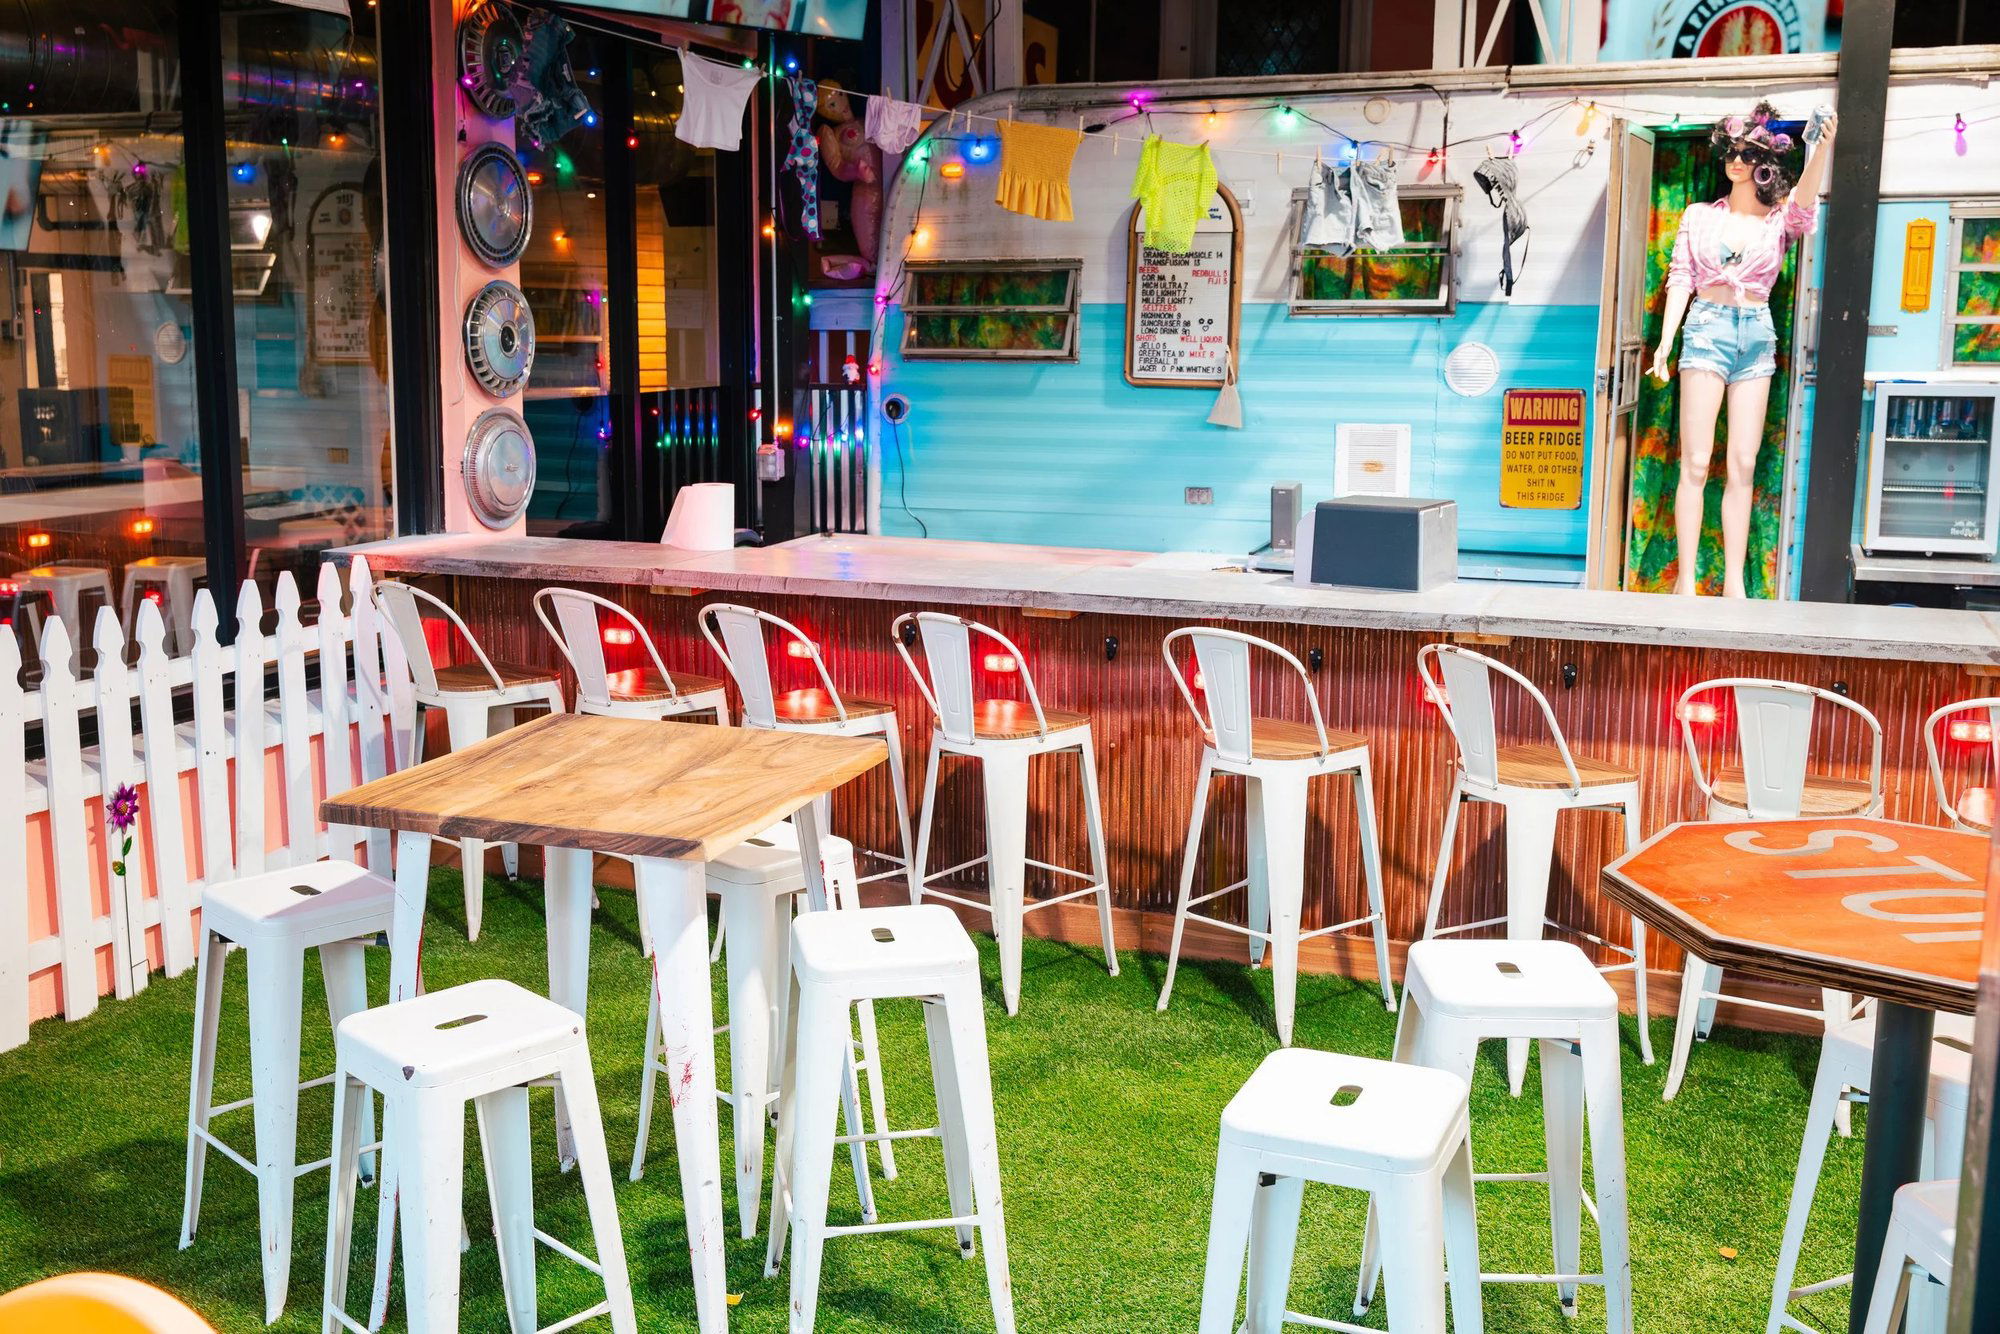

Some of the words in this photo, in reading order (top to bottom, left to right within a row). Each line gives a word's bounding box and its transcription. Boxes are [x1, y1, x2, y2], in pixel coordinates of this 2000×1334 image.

[1216, 251, 1222, 259] 14
[1192, 269, 1221, 277] REDBULL
[1142, 281, 1158, 289] MICH
[1208, 277, 1221, 285] FIJI
[1223, 277, 1228, 285] 5
[1142, 289, 1155, 297] BUD
[1168, 297, 1187, 305] LIGHT
[1189, 297, 1194, 305] 7
[1142, 304, 1178, 312] SELTZERS
[1141, 327, 1158, 335] LONG
[1160, 327, 1179, 335] DRINK
[1136, 334, 1156, 342] SHOTS
[1139, 342, 1161, 350] JELLO
[1138, 349, 1161, 357] GREEN
[1162, 350, 1177, 358] TEA
[1178, 350, 1185, 358] 10
[1138, 357, 1170, 365] FIREBALL
[1509, 397, 1580, 420] WARNING
[1505, 431, 1535, 445] BEER
[1539, 431, 1582, 446] FRIDGE
[1505, 450, 1517, 459] DO
[1519, 450, 1535, 460] NOT
[1538, 451, 1553, 460] PUT
[1555, 451, 1579, 462] FOOD,
[1506, 464, 1536, 474] WATER,
[1538, 464, 1549, 474] OR
[1551, 465, 1578, 474] OTHER
[1527, 478, 1545, 487] SHIT
[1547, 478, 1556, 488] IN
[1517, 491, 1535, 501] THIS
[1537, 492, 1566, 502] FRIDGE
